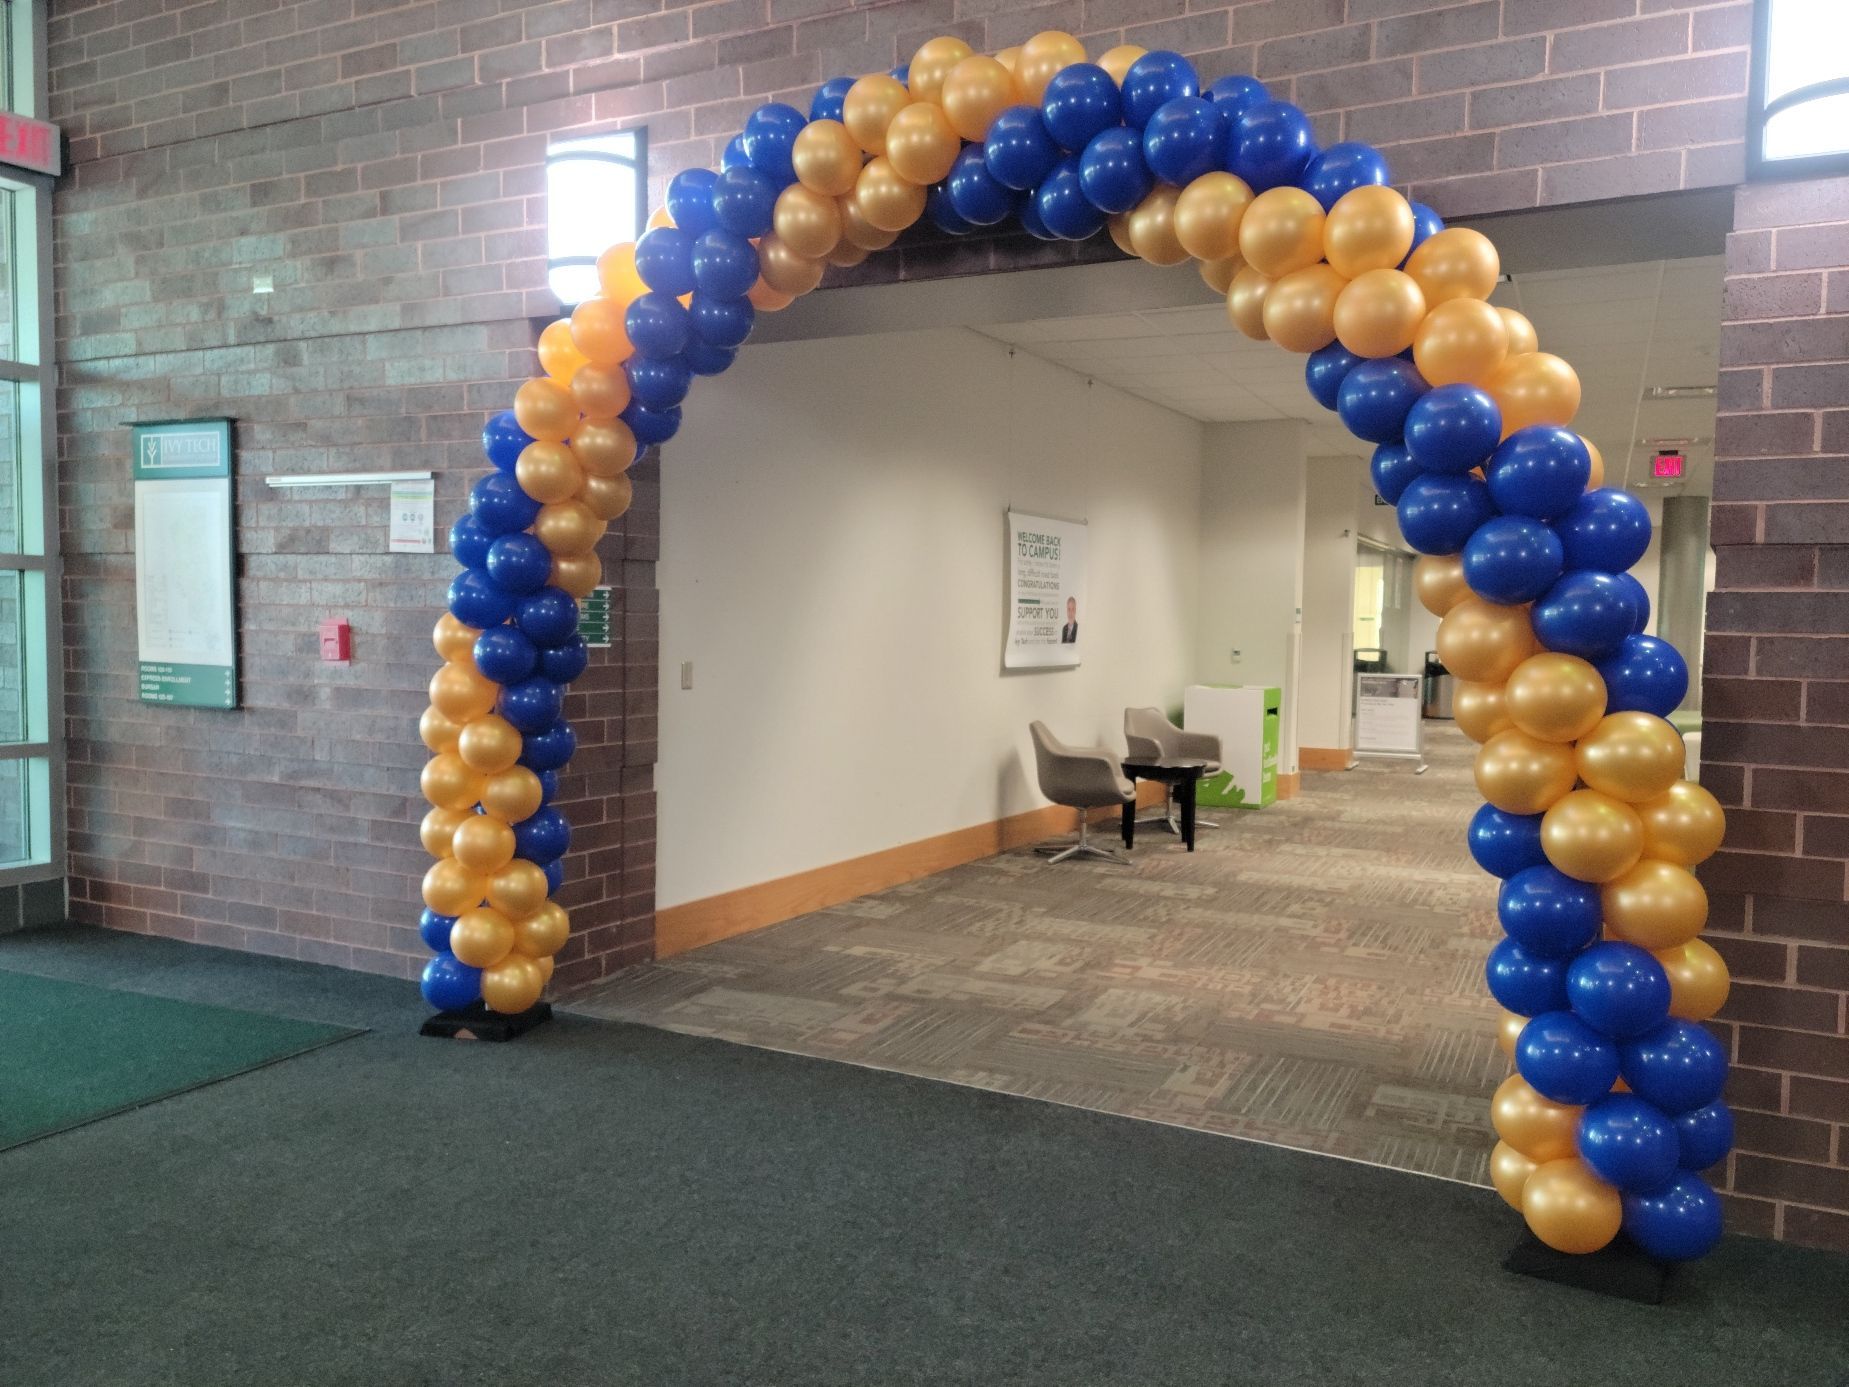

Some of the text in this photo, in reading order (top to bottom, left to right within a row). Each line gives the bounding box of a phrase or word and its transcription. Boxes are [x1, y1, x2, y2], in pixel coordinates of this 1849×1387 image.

[164, 438, 217, 454] IVY TECH
[1655, 456, 1681, 476] EXIT
[1018, 532, 1061, 546] WELCOME BACK
[1018, 543, 1061, 560] TO CAMPUS!
[1018, 579, 1060, 590] CONGRATULATIONS
[1018, 606, 1059, 619] SUPPORT YOU
